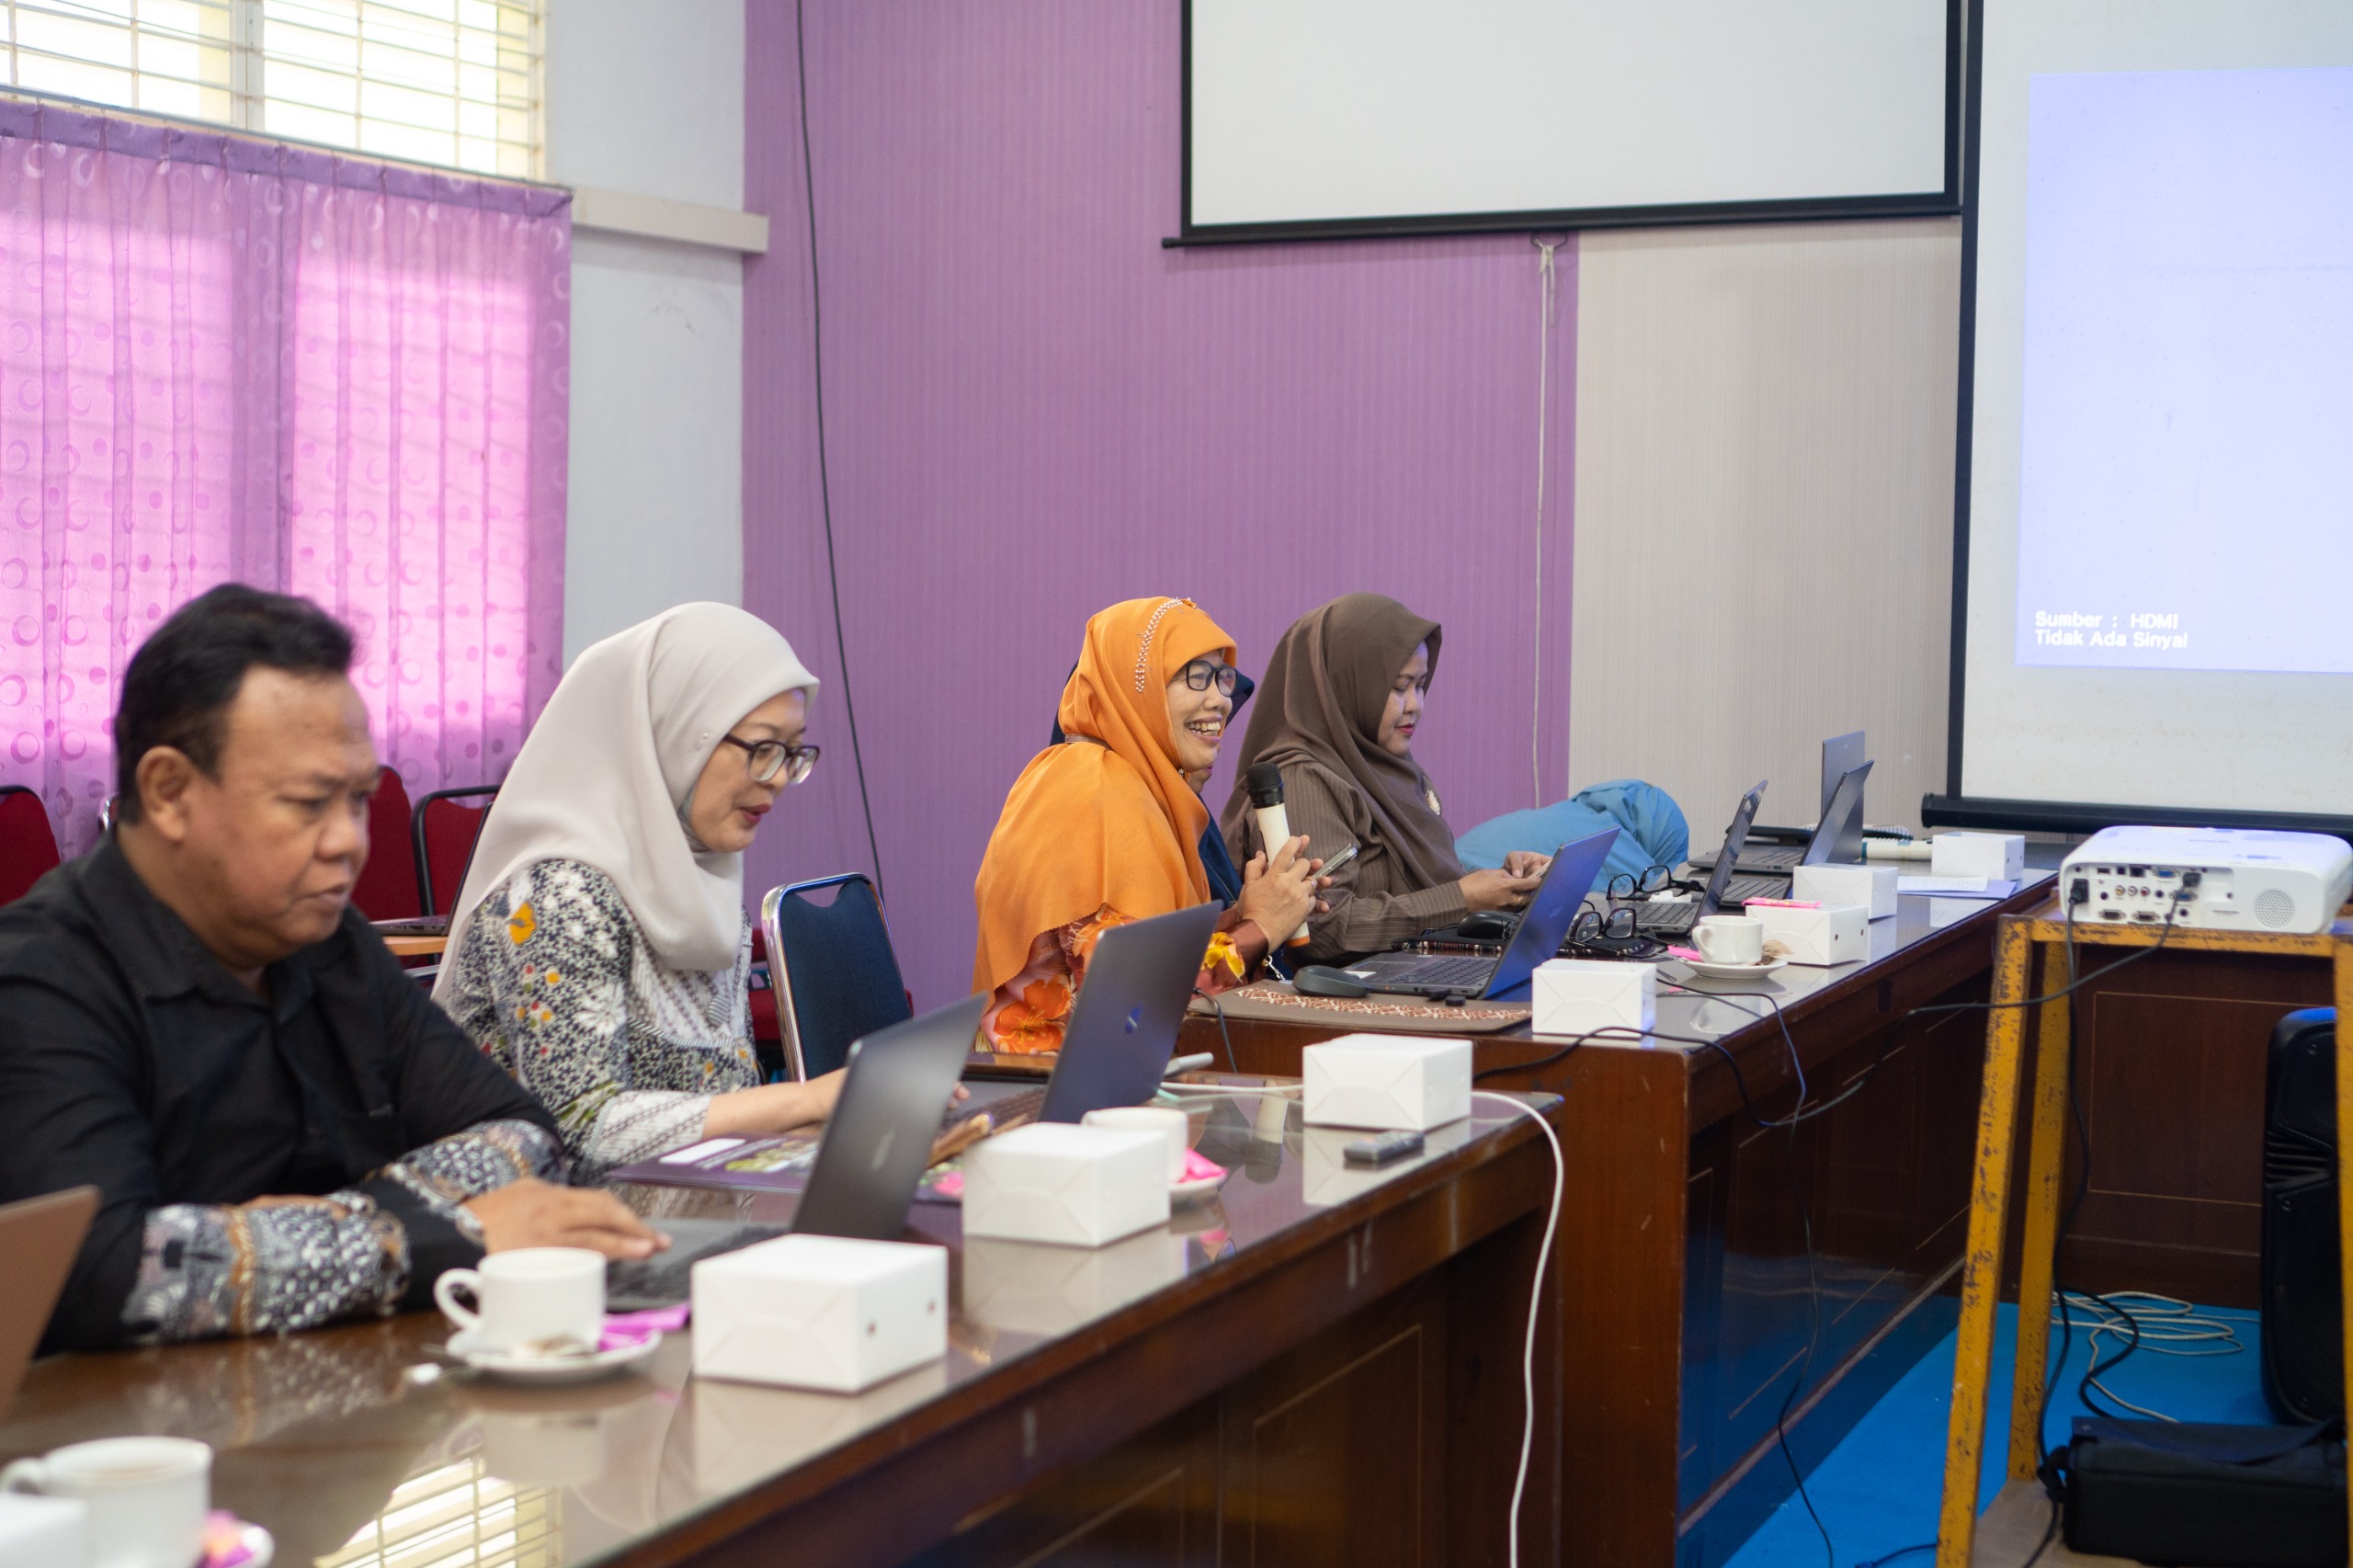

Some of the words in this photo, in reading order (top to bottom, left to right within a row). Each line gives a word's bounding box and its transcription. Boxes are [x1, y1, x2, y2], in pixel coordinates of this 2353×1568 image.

[2034, 610, 2103, 628] Sumber
[2130, 612, 2178, 630] HDMI
[2034, 629, 2085, 645] Tidak
[2089, 631, 2127, 647] Ada
[2132, 631, 2188, 650] Sinyal
